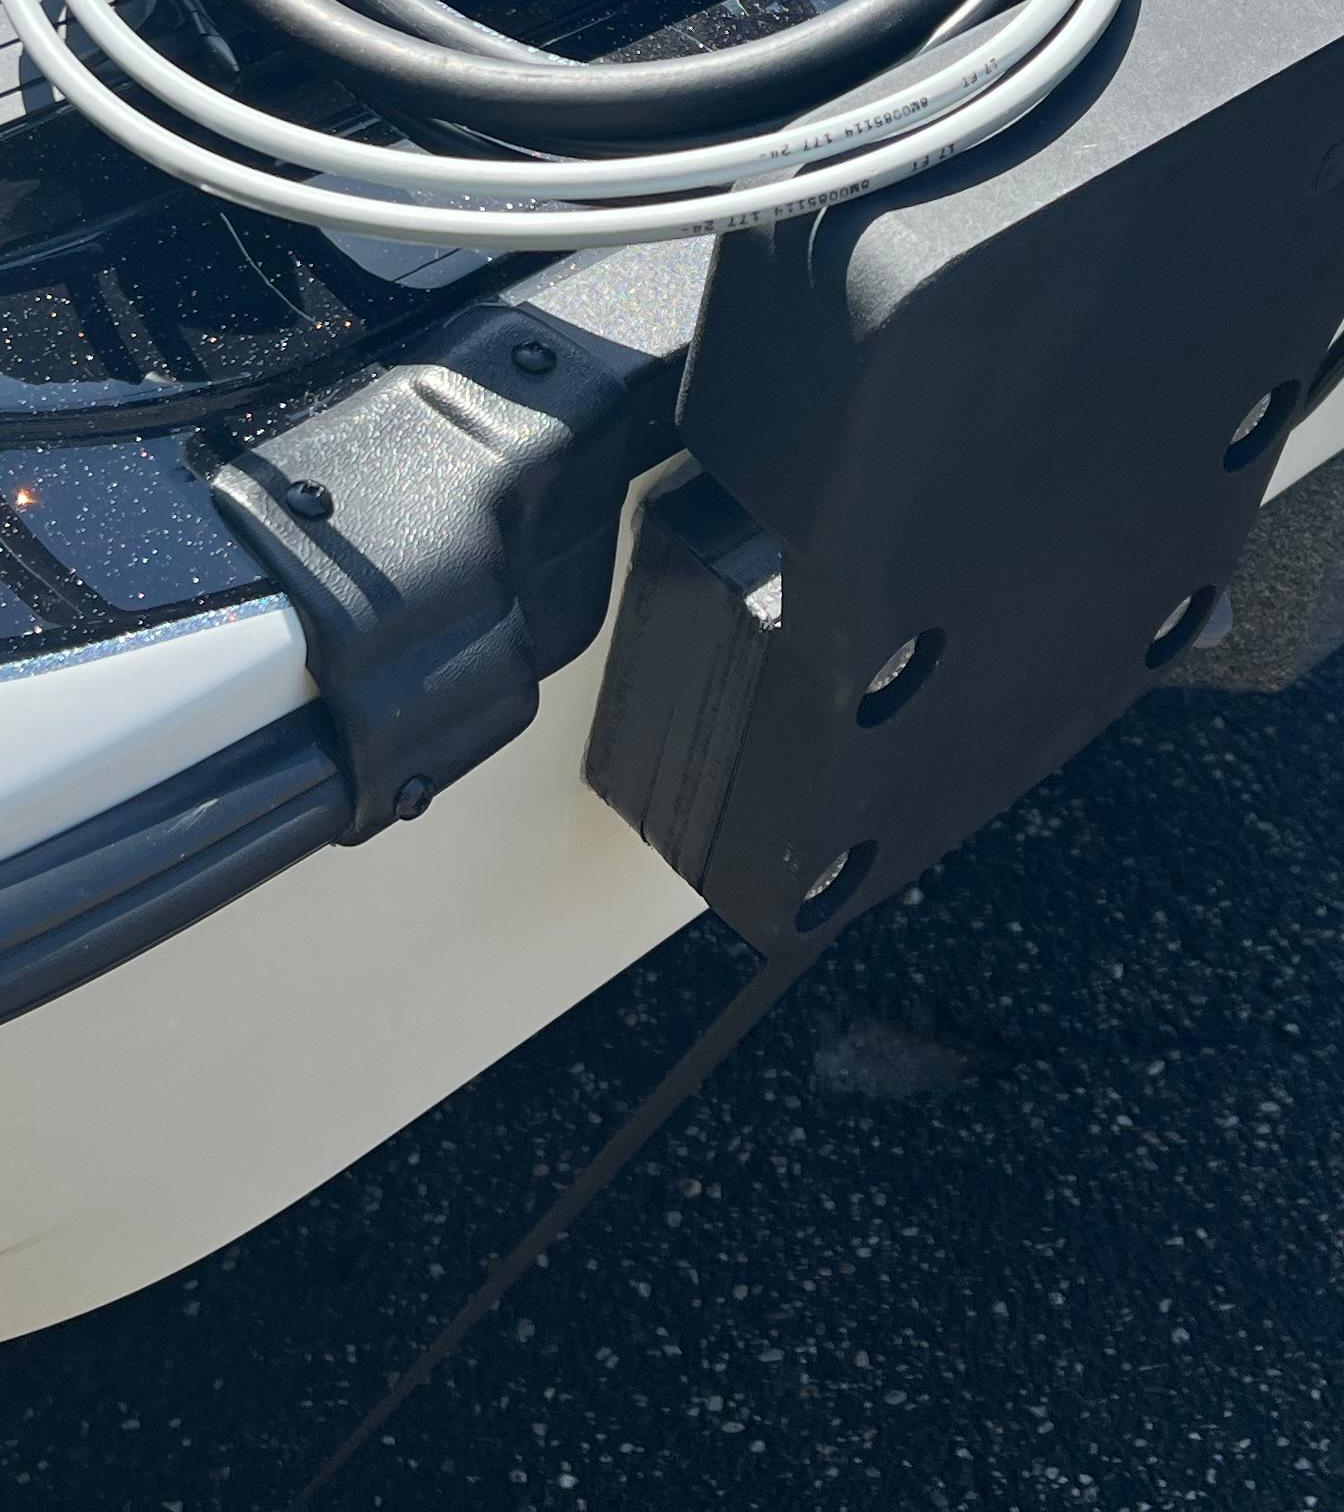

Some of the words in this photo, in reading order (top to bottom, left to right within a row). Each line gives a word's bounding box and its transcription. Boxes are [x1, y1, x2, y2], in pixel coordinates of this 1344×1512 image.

[985, 57, 999, 76] 17
[962, 70, 978, 88] FT
[844, 96, 929, 138] 8M0085114
[939, 143, 956, 160] 17
[911, 155, 930, 173] FT
[774, 179, 870, 218] 8M0085114
